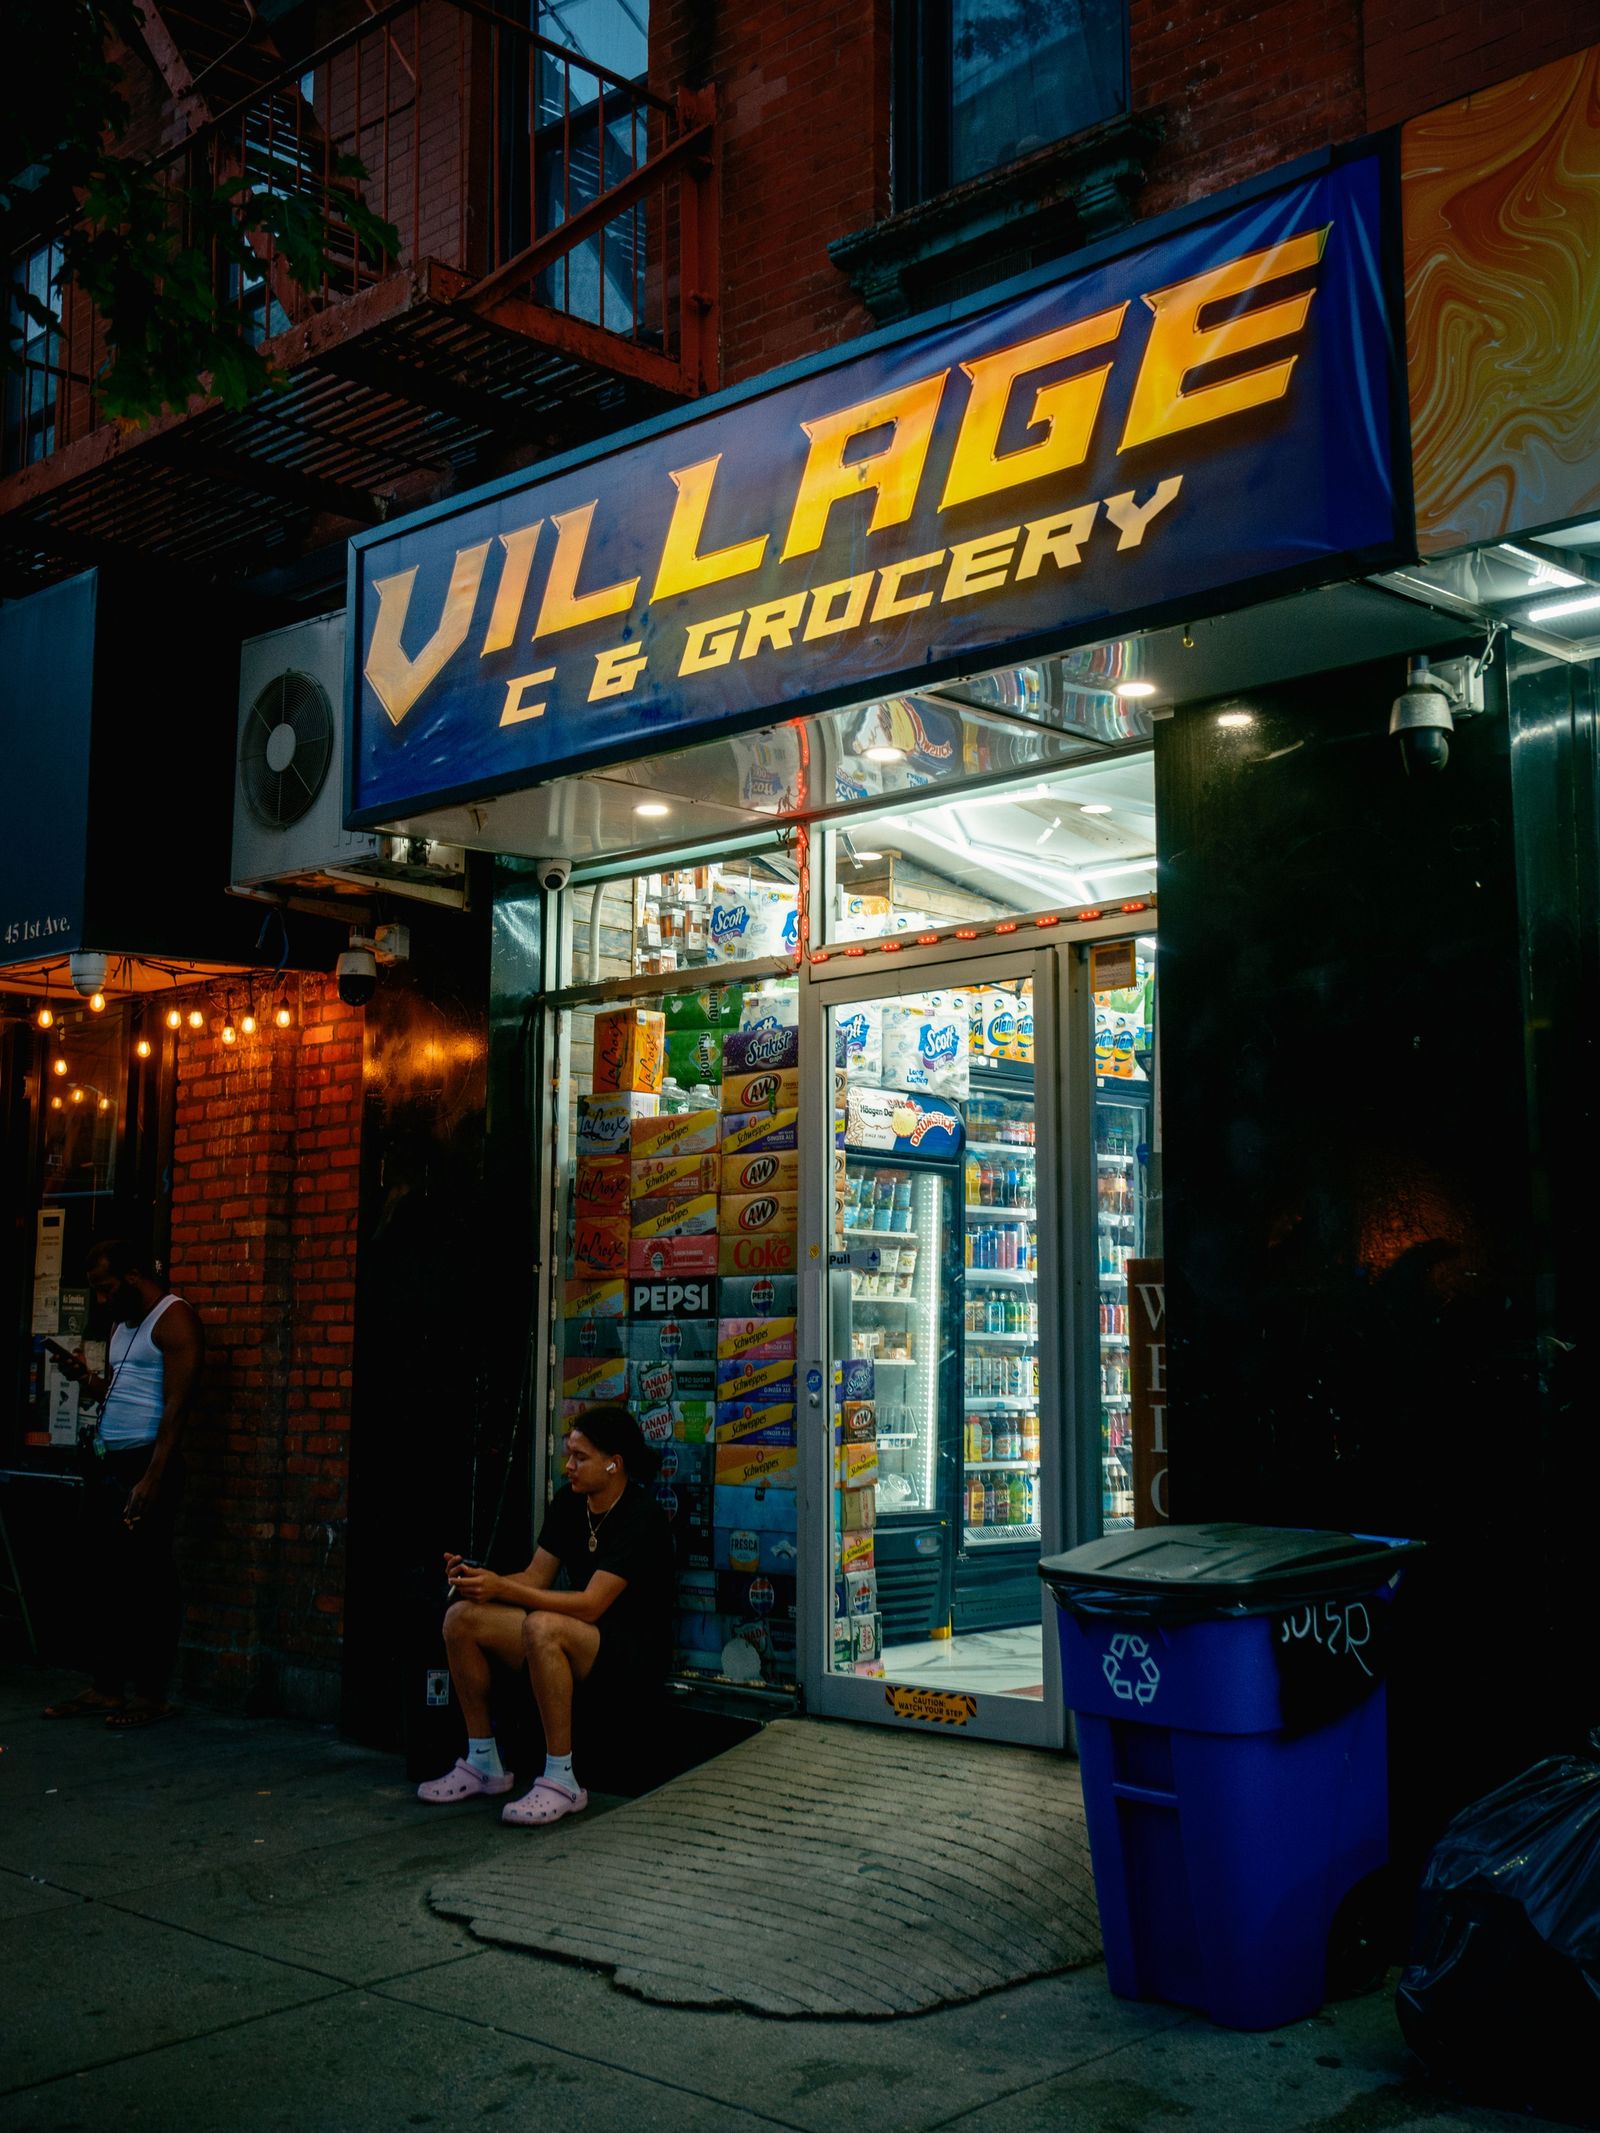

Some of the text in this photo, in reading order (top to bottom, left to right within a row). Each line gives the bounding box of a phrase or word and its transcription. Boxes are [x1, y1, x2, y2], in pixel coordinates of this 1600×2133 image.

[364, 221, 1334, 727] VILLAGE
[499, 474, 1184, 727] C & GROCERY
[5, 915, 71, 944] 45 1st Ave.
[715, 906, 745, 932] Scott
[746, 1031, 793, 1066] Sunkist
[925, 1025, 956, 1056] Scott
[656, 1125, 689, 1149] Schweppes
[736, 1120, 772, 1147] Schweppes
[910, 1112, 957, 1147] DRUMSTICK
[645, 1166, 678, 1192] Schweppes
[655, 1206, 690, 1231] Schweppes
[733, 1238, 792, 1269] Coke
[829, 1253, 851, 1265] Pull
[634, 1284, 709, 1312] PEPSI
[752, 1292, 774, 1301] PEPSI
[660, 1335, 682, 1345] PEPSI
[733, 1328, 769, 1351] Schweppes
[641, 1371, 674, 1392] CANADA
[650, 1387, 668, 1400] DRY
[732, 1371, 768, 1395] Schweppes
[639, 1411, 674, 1432] CANADA
[649, 1425, 667, 1441] DRY
[731, 1414, 768, 1436] Schweppes
[742, 1457, 780, 1481] Schweppes
[730, 1538, 758, 1551] FRESCA
[898, 1702, 963, 1718] WATCH YOUR STEP
[912, 1696, 946, 1708] CAUTION:
